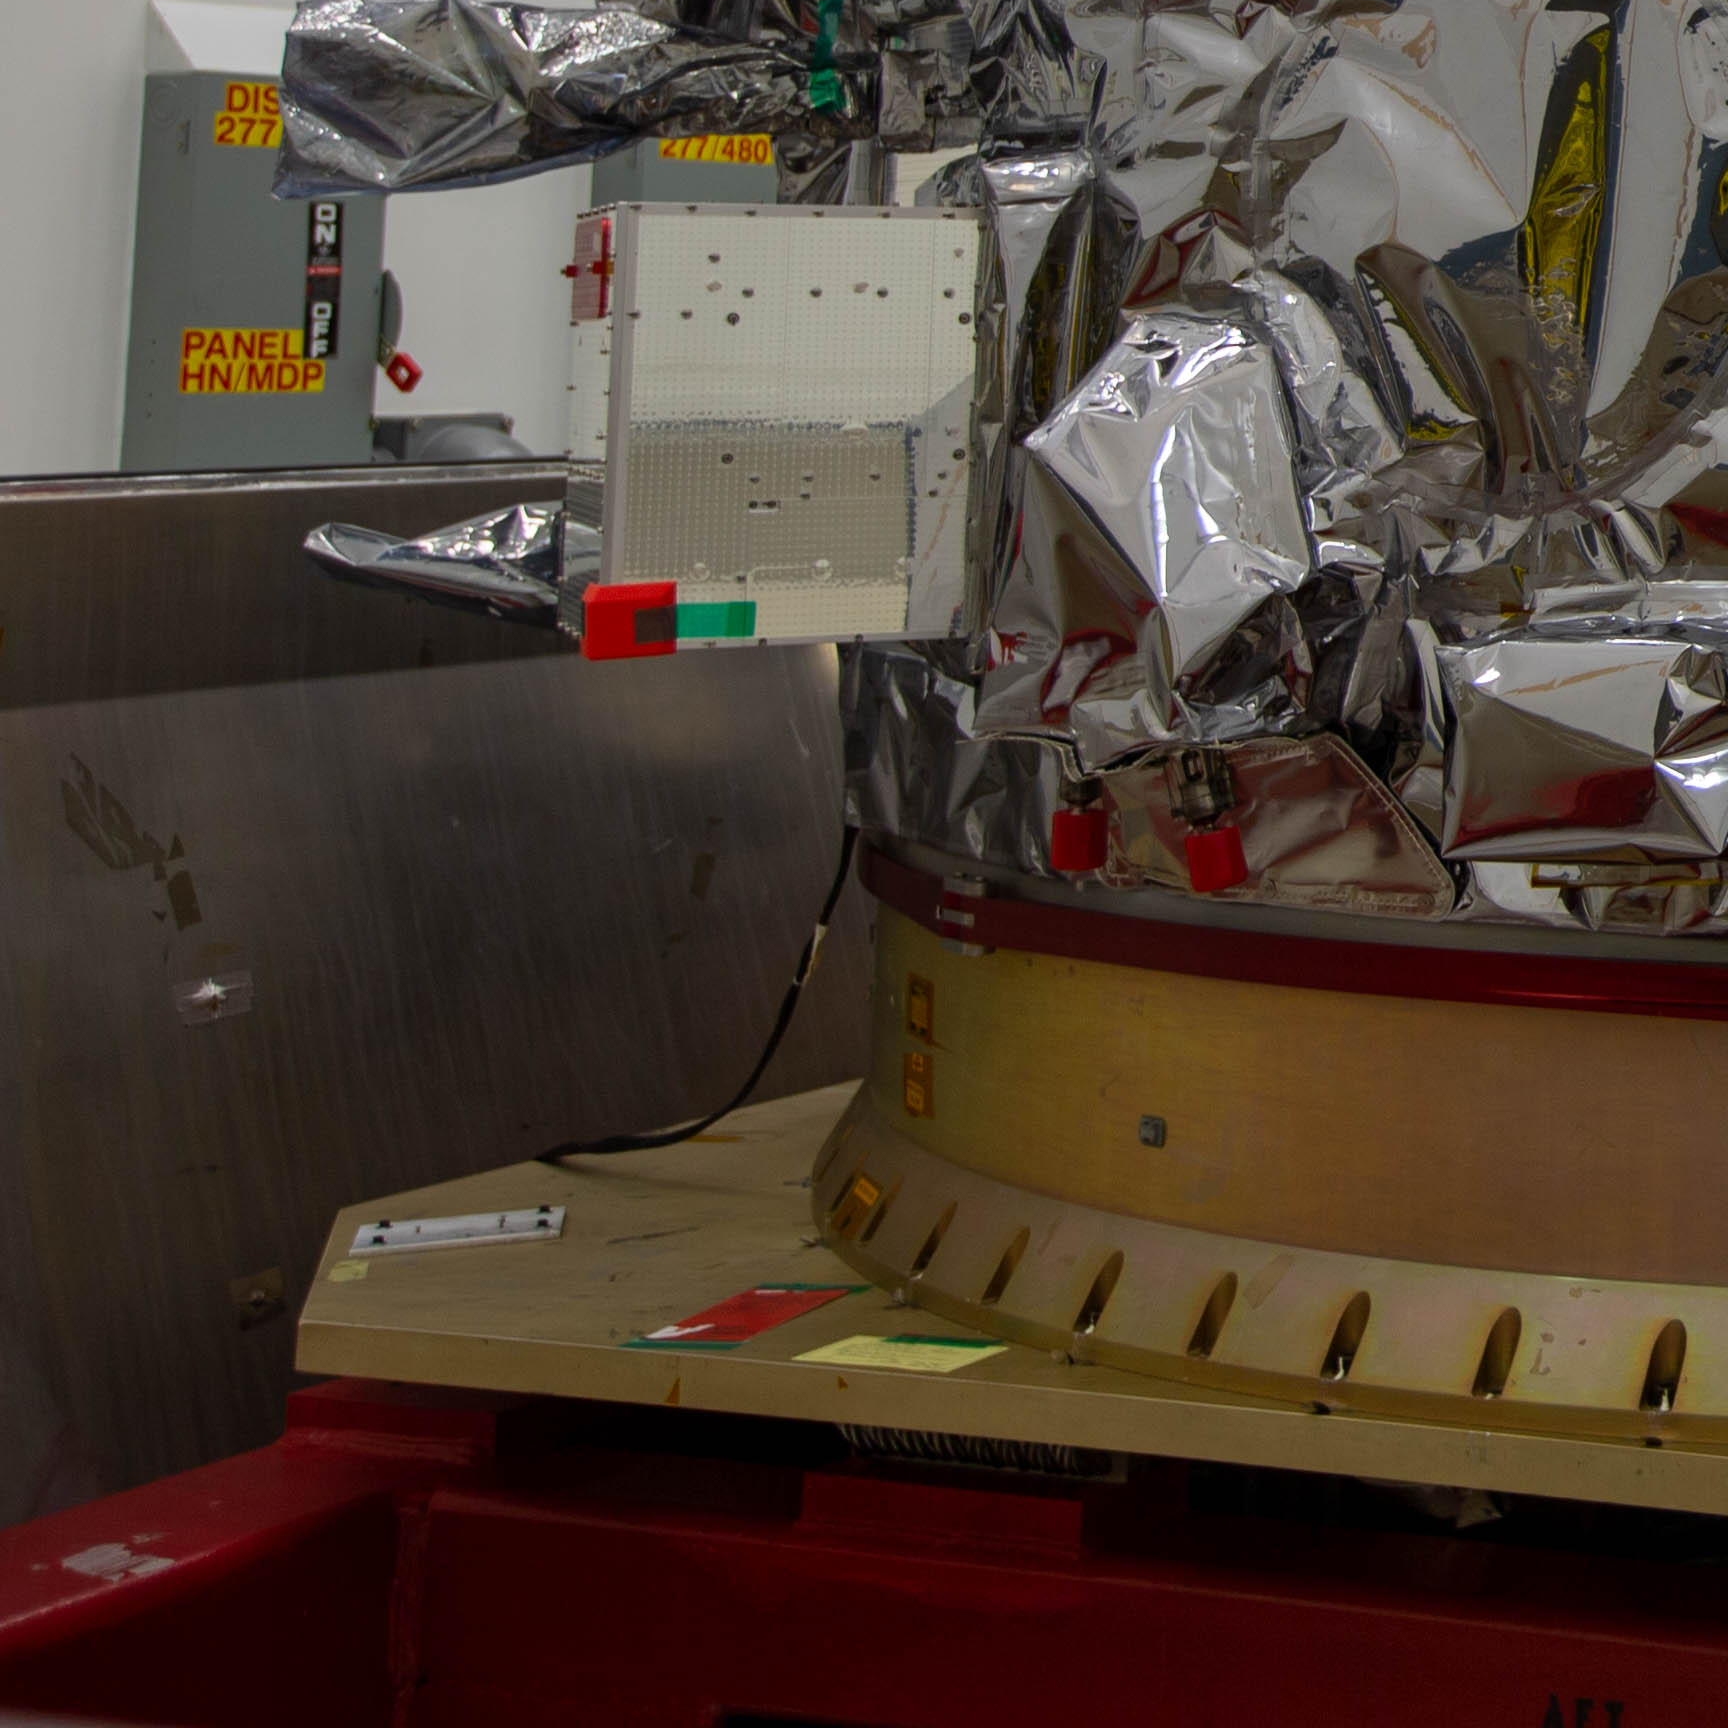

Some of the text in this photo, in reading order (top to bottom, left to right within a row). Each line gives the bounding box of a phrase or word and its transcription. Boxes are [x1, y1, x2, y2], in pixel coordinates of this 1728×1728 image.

[217, 116, 277, 145] 277
[662, 135, 768, 163] 277/480
[315, 203, 337, 244] ON
[310, 302, 332, 358] OFF
[184, 331, 300, 360] PANEL
[181, 362, 323, 391] HN/MDP
